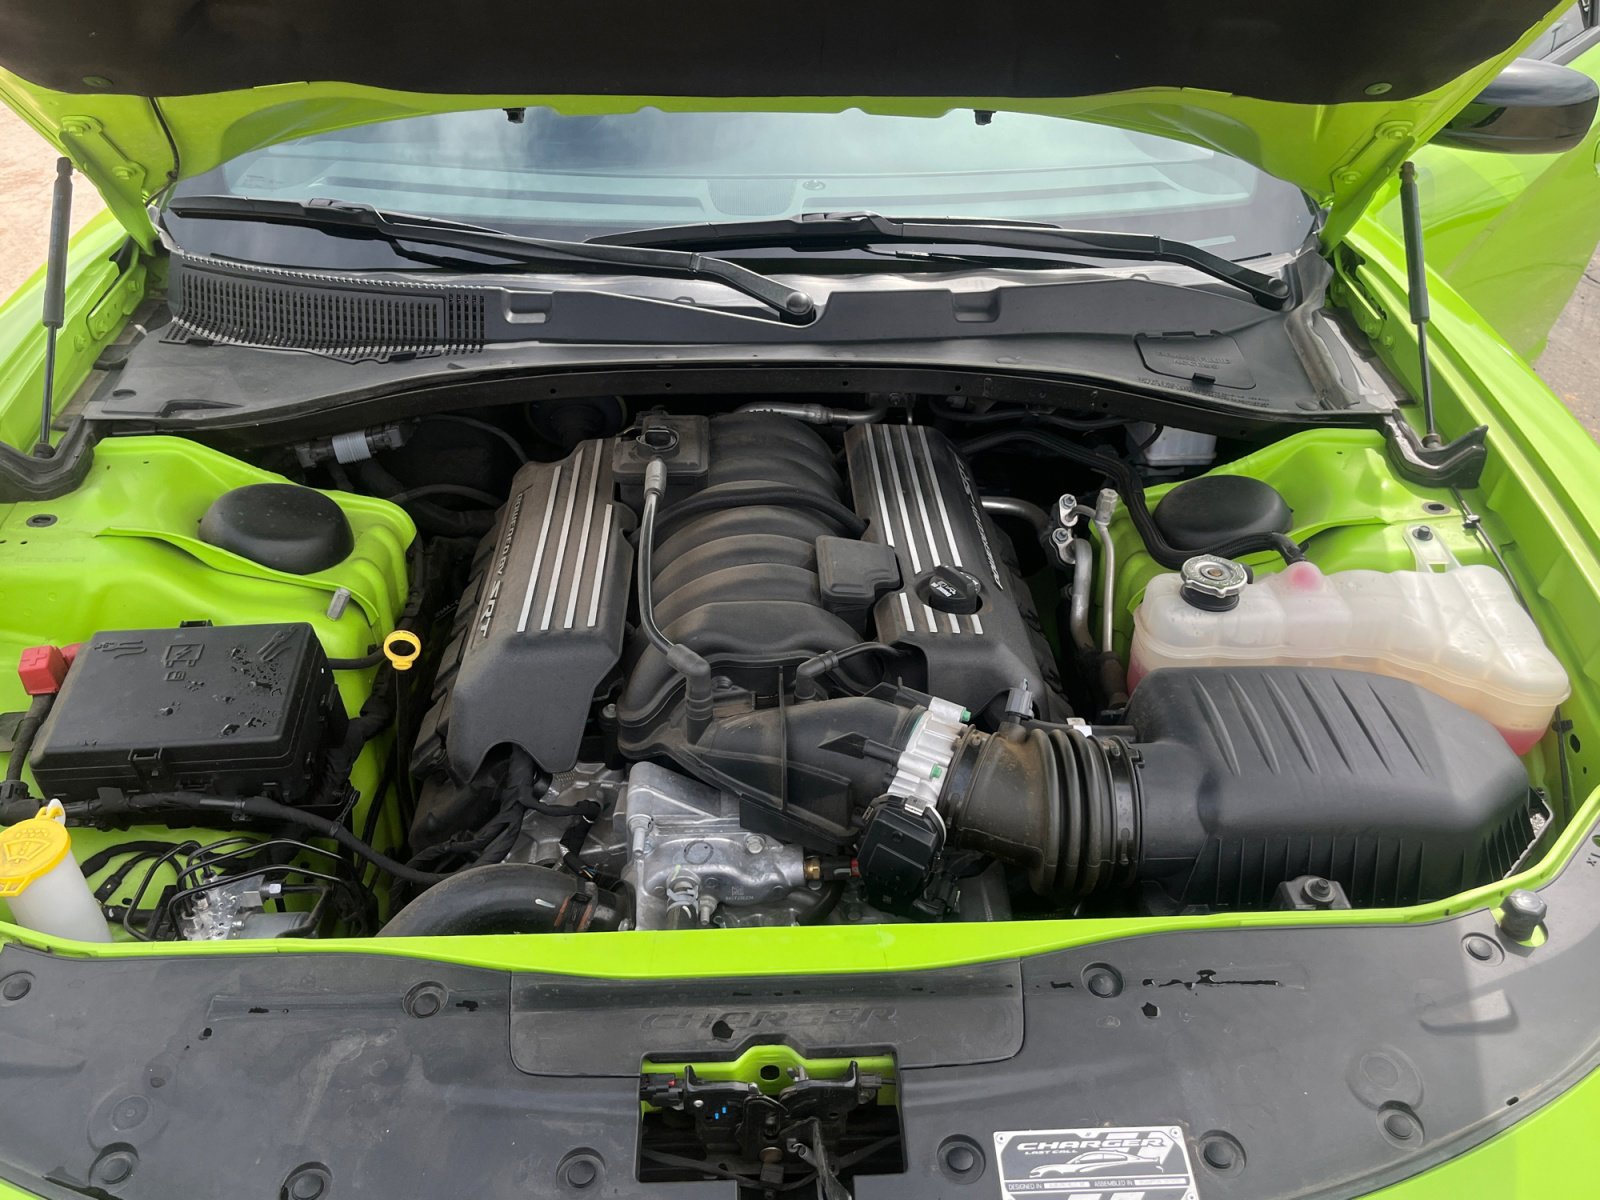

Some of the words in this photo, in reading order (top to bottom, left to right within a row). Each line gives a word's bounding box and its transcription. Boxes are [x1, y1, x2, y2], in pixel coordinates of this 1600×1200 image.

[502, 492, 523, 555] POWERED
[497, 556, 507, 575] BY
[480, 580, 501, 637] SRT
[1017, 1138, 1167, 1151] CHARGER
[1008, 1183, 1035, 1191] DESIGNED
